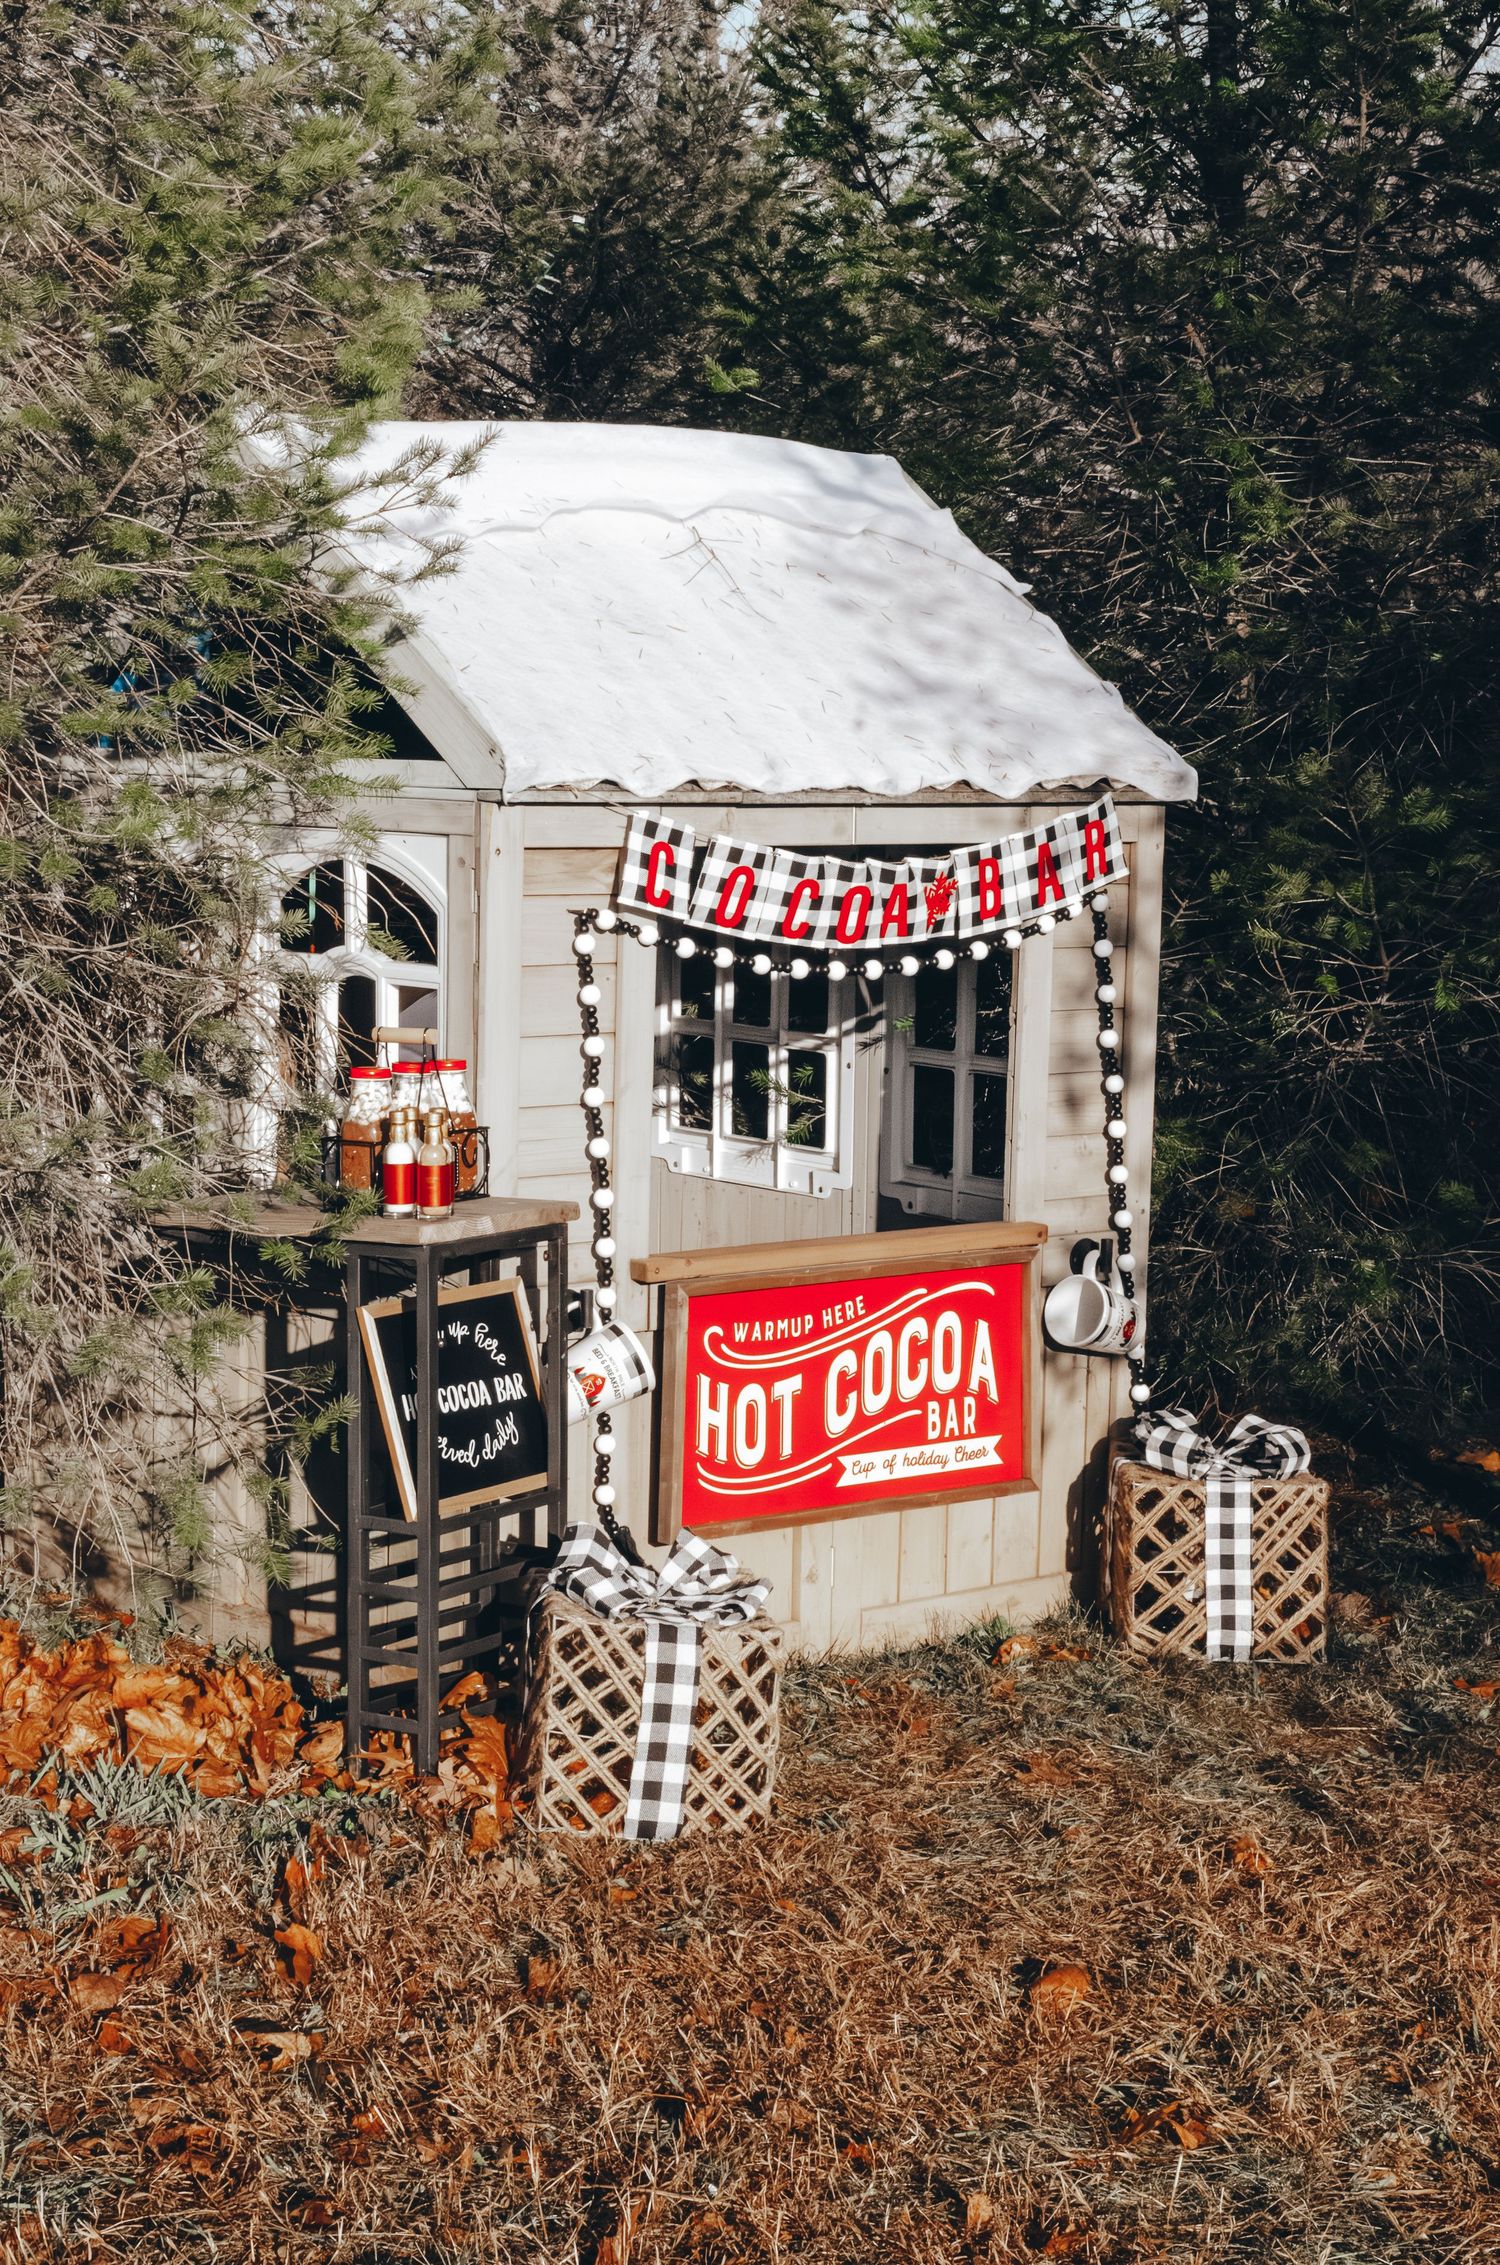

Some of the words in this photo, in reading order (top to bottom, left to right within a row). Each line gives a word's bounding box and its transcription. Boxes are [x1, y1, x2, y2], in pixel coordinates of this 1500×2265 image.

[645, 841, 909, 945] COCOA
[979, 819, 1108, 920] BAR
[733, 1314, 814, 1343] WARMUP
[822, 1295, 866, 1329] HERE
[475, 1323, 506, 1366] here
[438, 1380, 492, 1414] COCOA
[493, 1373, 528, 1403] BAR
[592, 1347, 604, 1360] BED
[604, 1364, 622, 1400] BREAKFAST
[695, 1372, 803, 1470] HOT
[824, 1310, 999, 1439] COCOA
[482, 1411, 519, 1460] daily
[927, 1396, 977, 1440] BAR
[851, 1460, 876, 1479] Cup
[883, 1454, 897, 1475] of
[902, 1449, 950, 1469] holiday
[954, 1445, 989, 1463] Cheer
